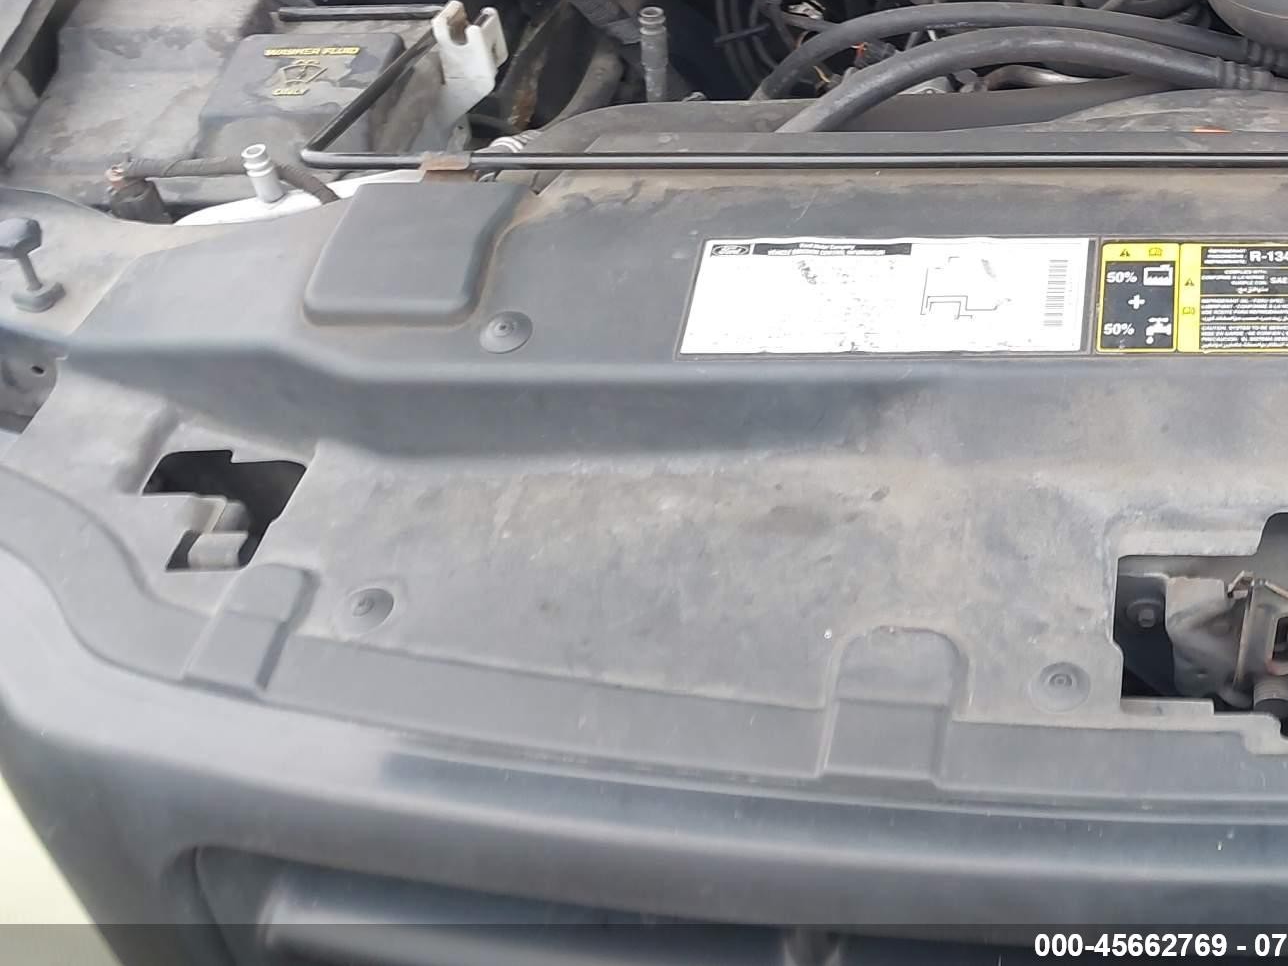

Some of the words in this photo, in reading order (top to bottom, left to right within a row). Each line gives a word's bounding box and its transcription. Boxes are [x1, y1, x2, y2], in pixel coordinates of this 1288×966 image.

[321, 47, 360, 55] FLUID
[1106, 271, 1138, 283] 50%
[1103, 323, 1135, 336] 50%
